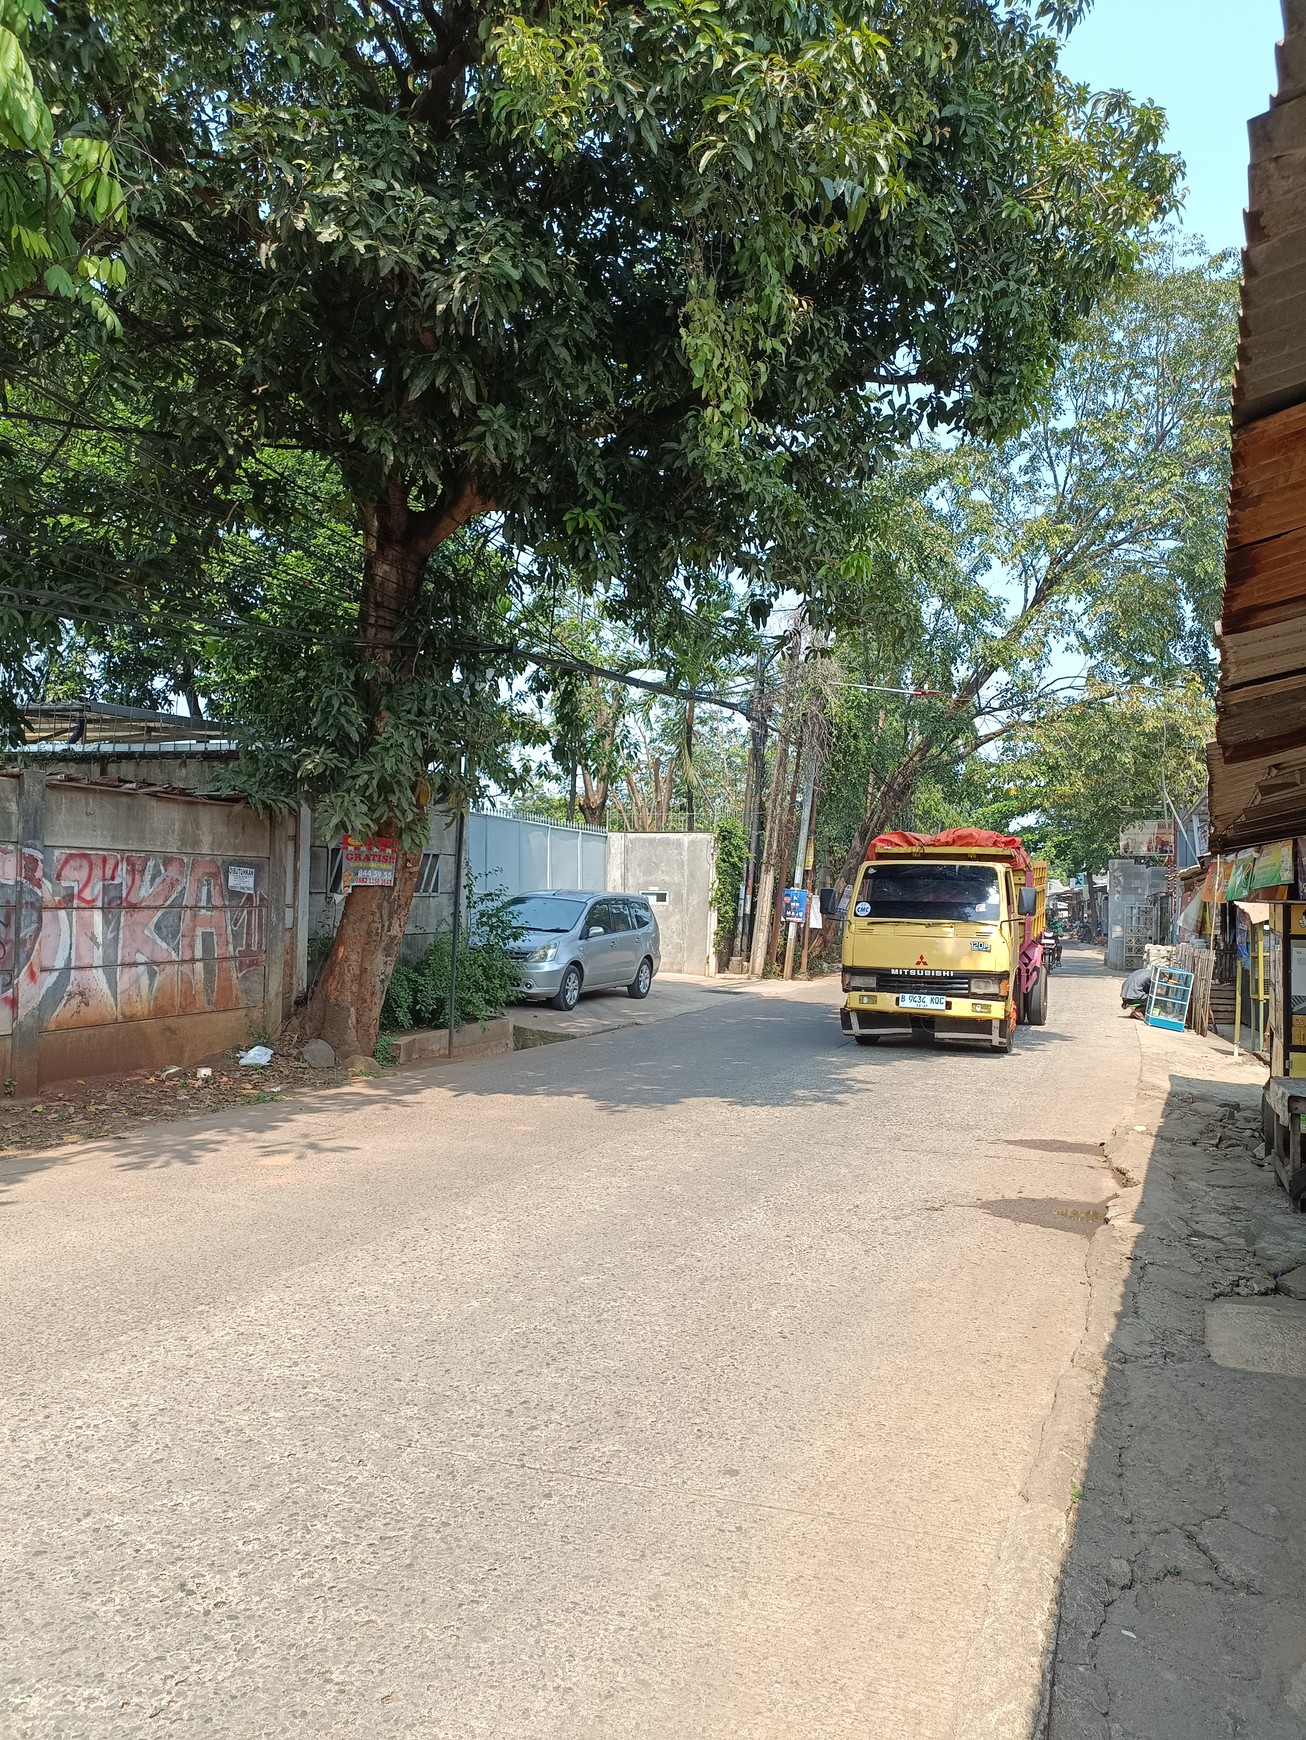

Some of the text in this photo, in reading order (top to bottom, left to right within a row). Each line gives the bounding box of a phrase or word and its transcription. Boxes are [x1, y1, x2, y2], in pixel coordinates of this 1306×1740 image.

[345, 853, 395, 864] GRATIS!!
[358, 869, 372, 877] 844
[891, 968, 954, 977] MITSUBISHI
[901, 994, 945, 1005] B 9434 KQC
